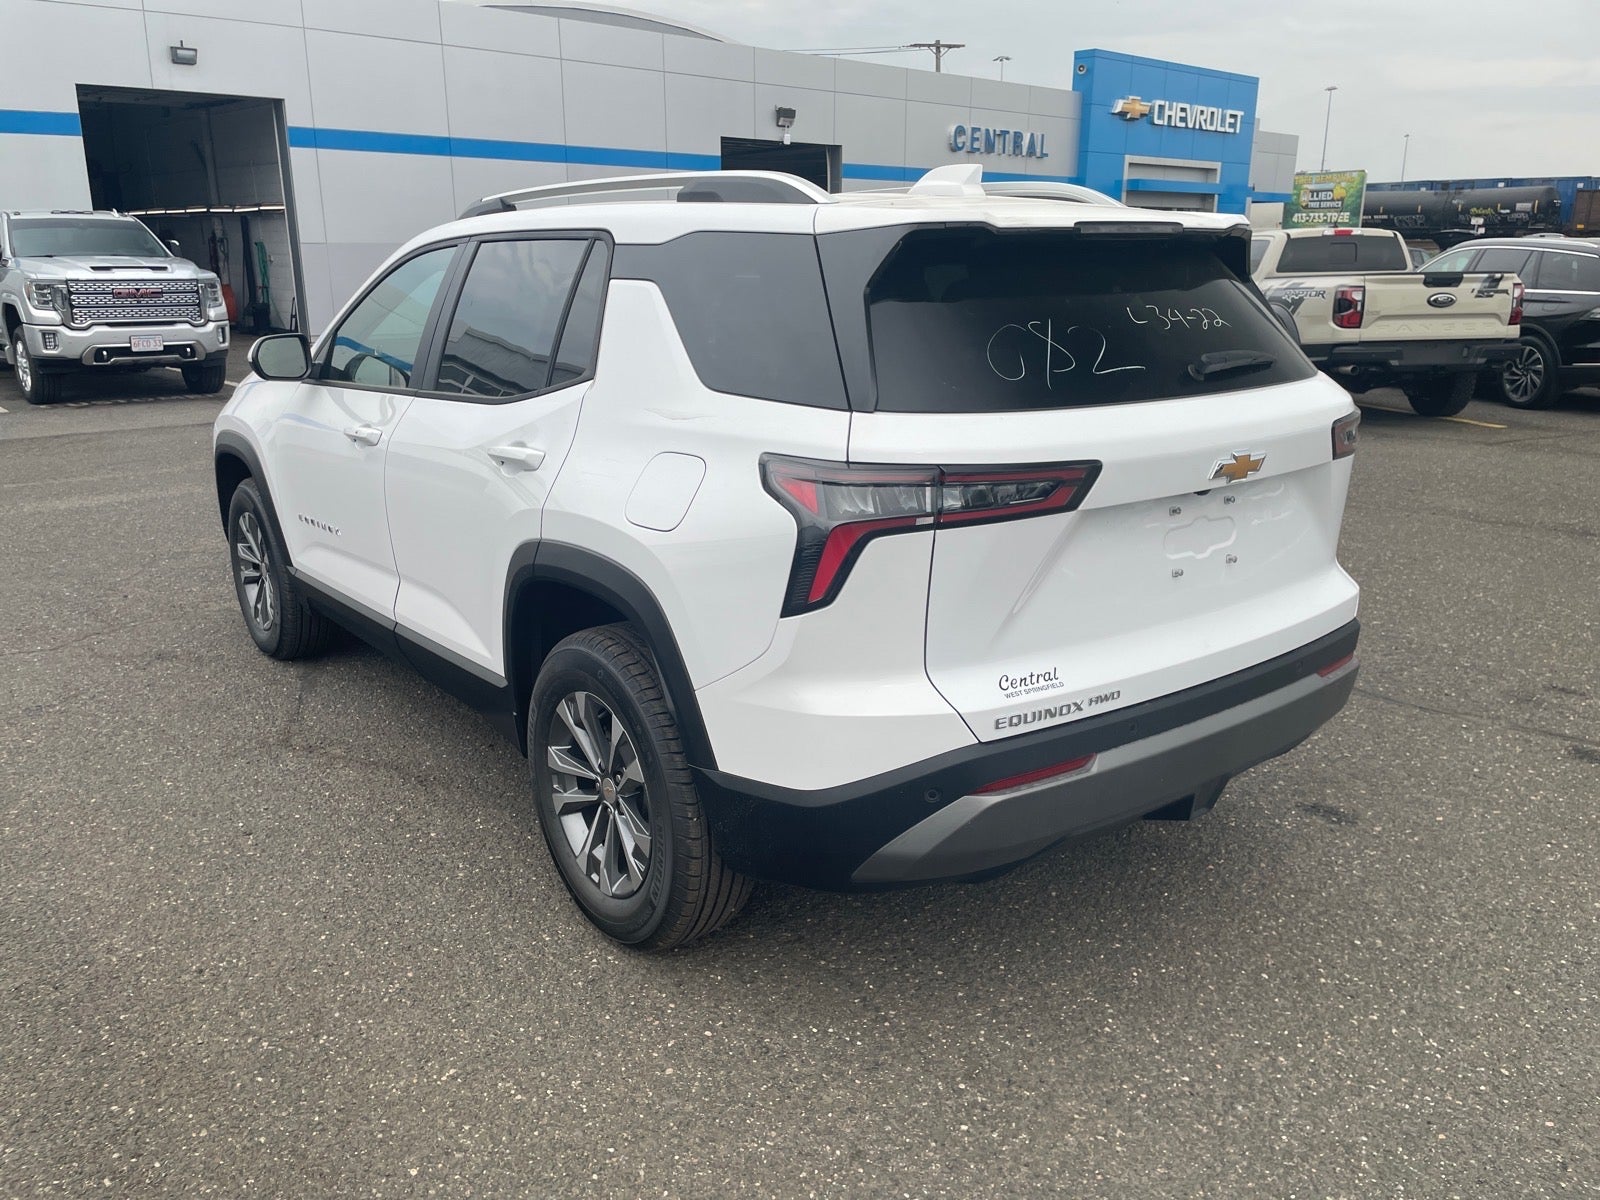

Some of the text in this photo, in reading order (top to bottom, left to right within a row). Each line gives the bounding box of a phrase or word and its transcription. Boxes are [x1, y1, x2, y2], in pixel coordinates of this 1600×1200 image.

[1153, 100, 1245, 134] CHEVROLET
[950, 124, 1049, 159] CENTRAL
[1321, 201, 1342, 209] SERVICE
[1292, 212, 1350, 224] 413-733-TREE
[113, 288, 162, 298] GMC
[1282, 290, 1326, 302] RAPTOR
[998, 667, 1059, 691] Central
[1004, 681, 1064, 699] WEST SPRINGFIELD
[994, 690, 1121, 730] EQUINOX AWD
